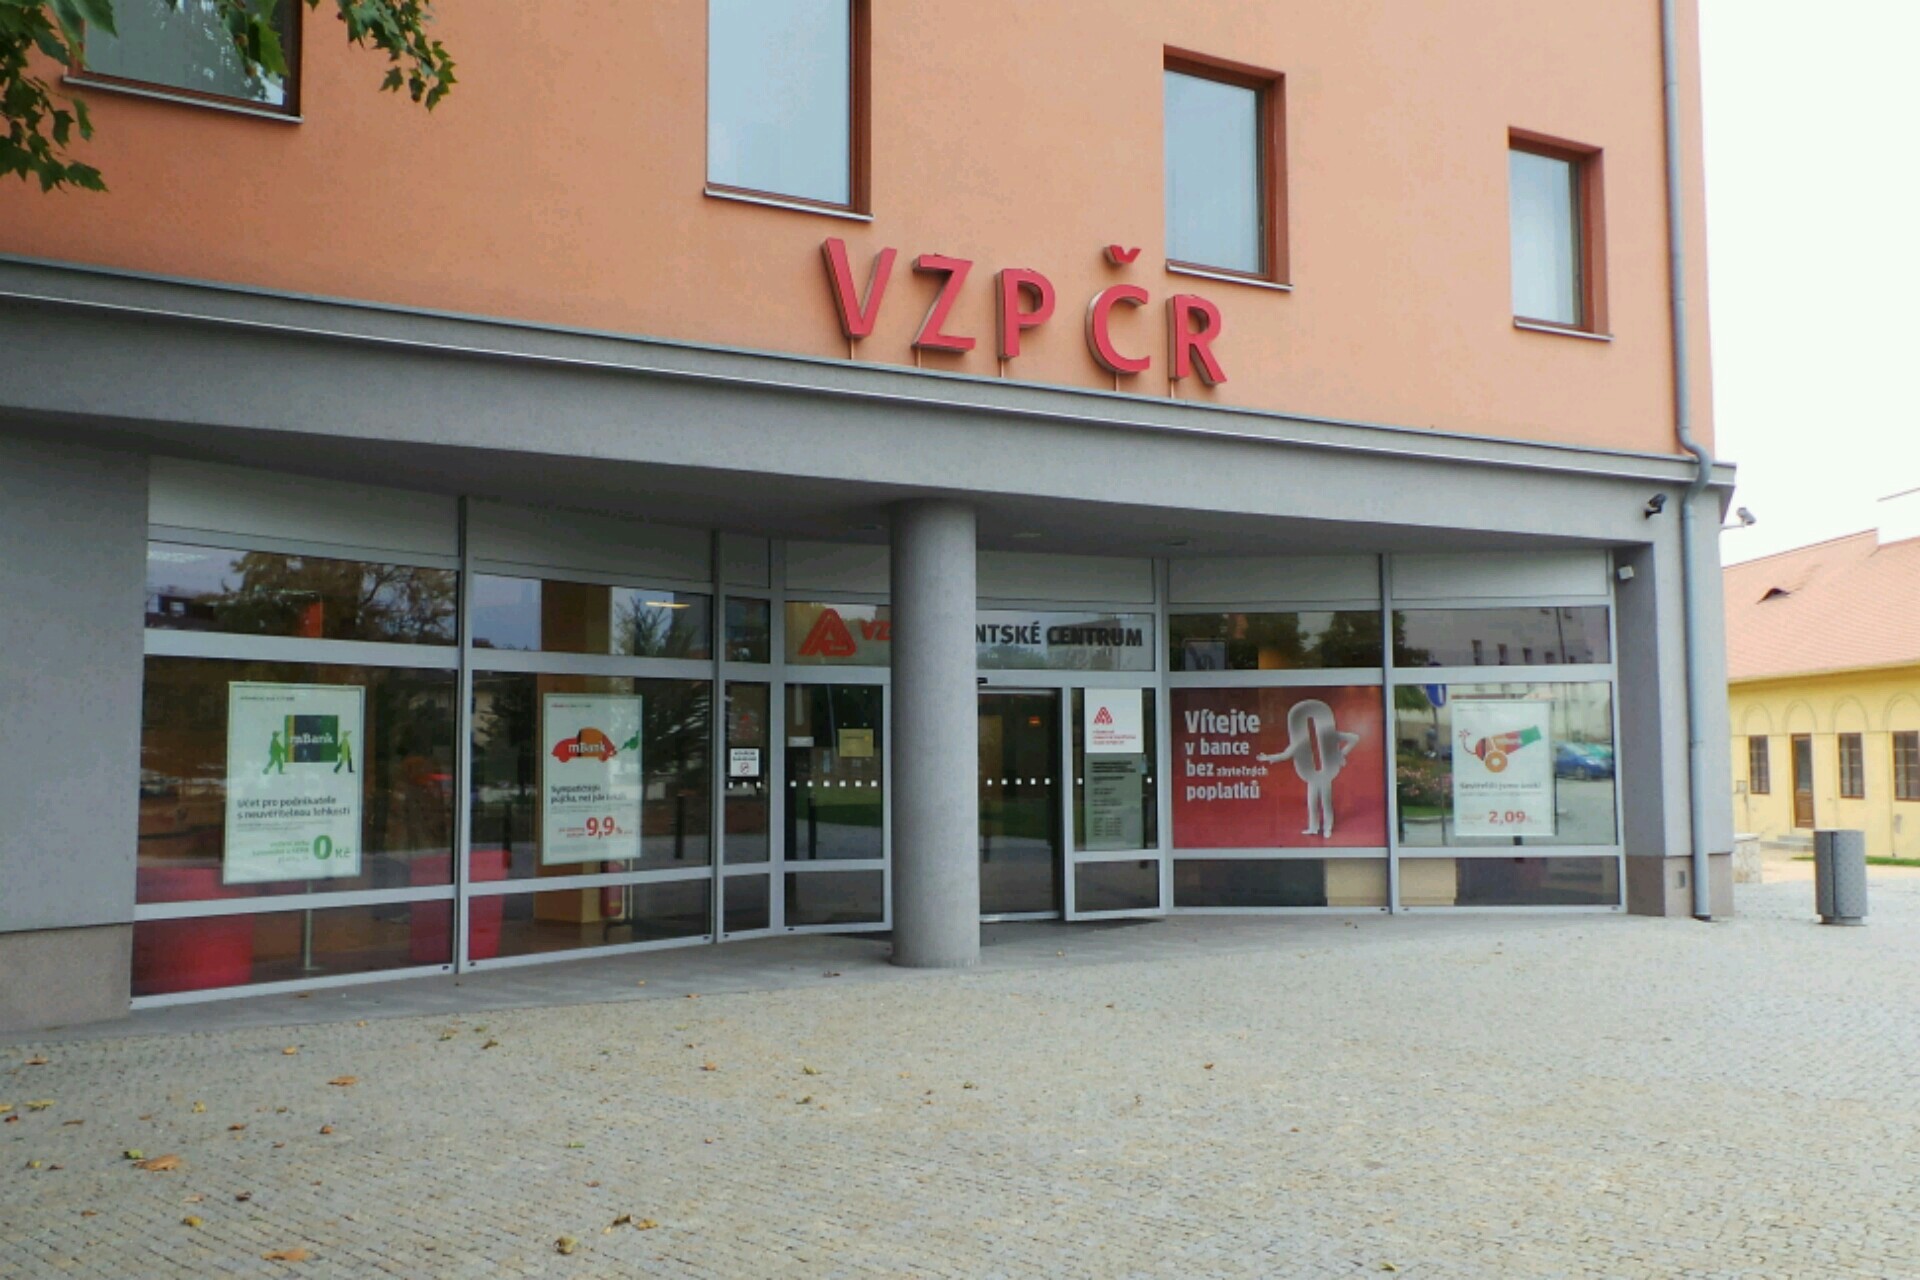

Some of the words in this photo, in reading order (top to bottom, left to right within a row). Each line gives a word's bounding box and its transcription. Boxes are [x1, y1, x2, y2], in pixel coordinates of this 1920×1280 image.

[1047, 626, 1143, 647] CENTRUM
[1184, 708, 1260, 737] Vítejte
[1184, 741, 1195, 756] v
[1200, 738, 1250, 756] bance
[1186, 759, 1215, 777] bez
[1186, 780, 1260, 802] poplatků
[586, 816, 615, 840] 9,9
[1489, 811, 1526, 825] 2,09
[313, 834, 333, 860] 0
